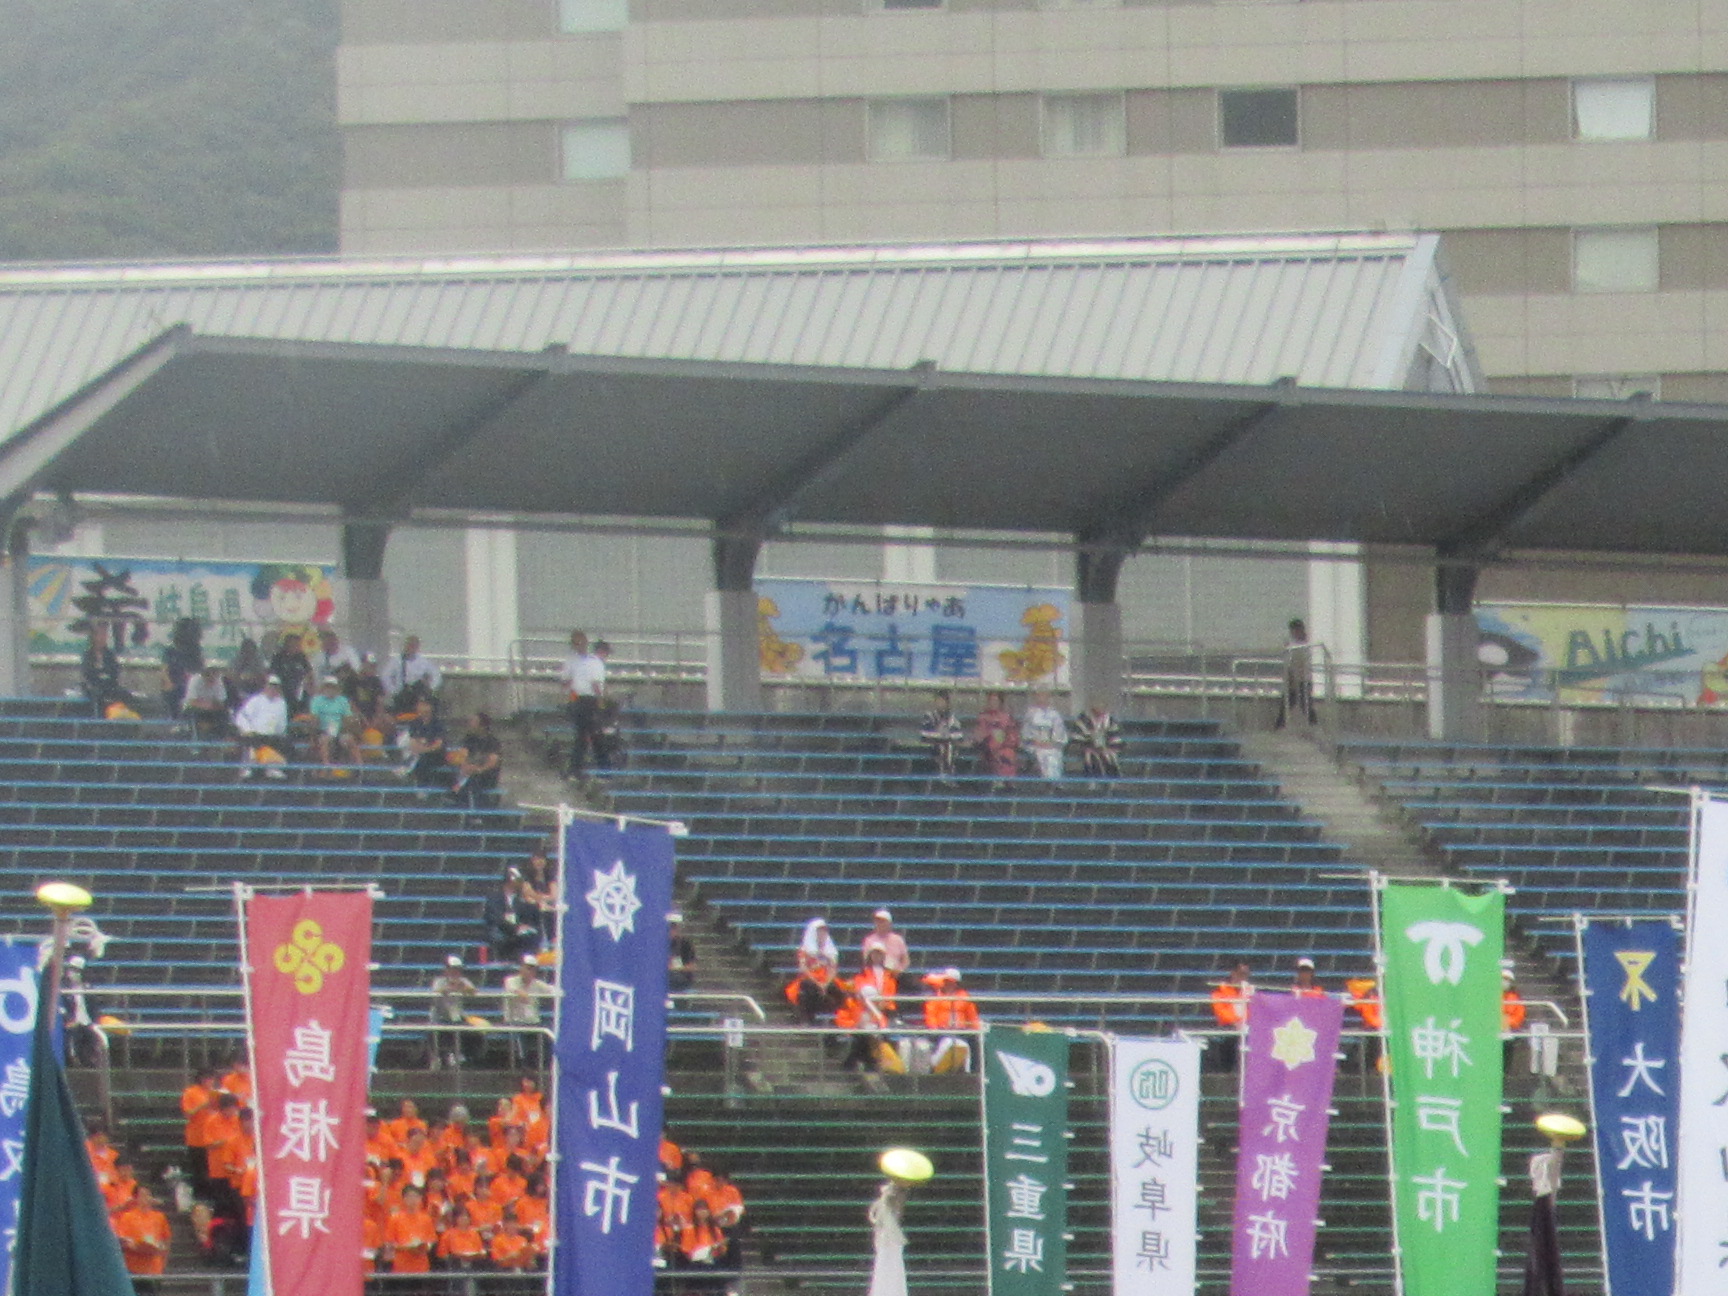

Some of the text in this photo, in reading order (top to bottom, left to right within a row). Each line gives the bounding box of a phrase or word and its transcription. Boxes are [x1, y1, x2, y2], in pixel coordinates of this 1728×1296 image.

[812, 621, 979, 677] 名古屋
[1566, 621, 1684, 669] Aichi
